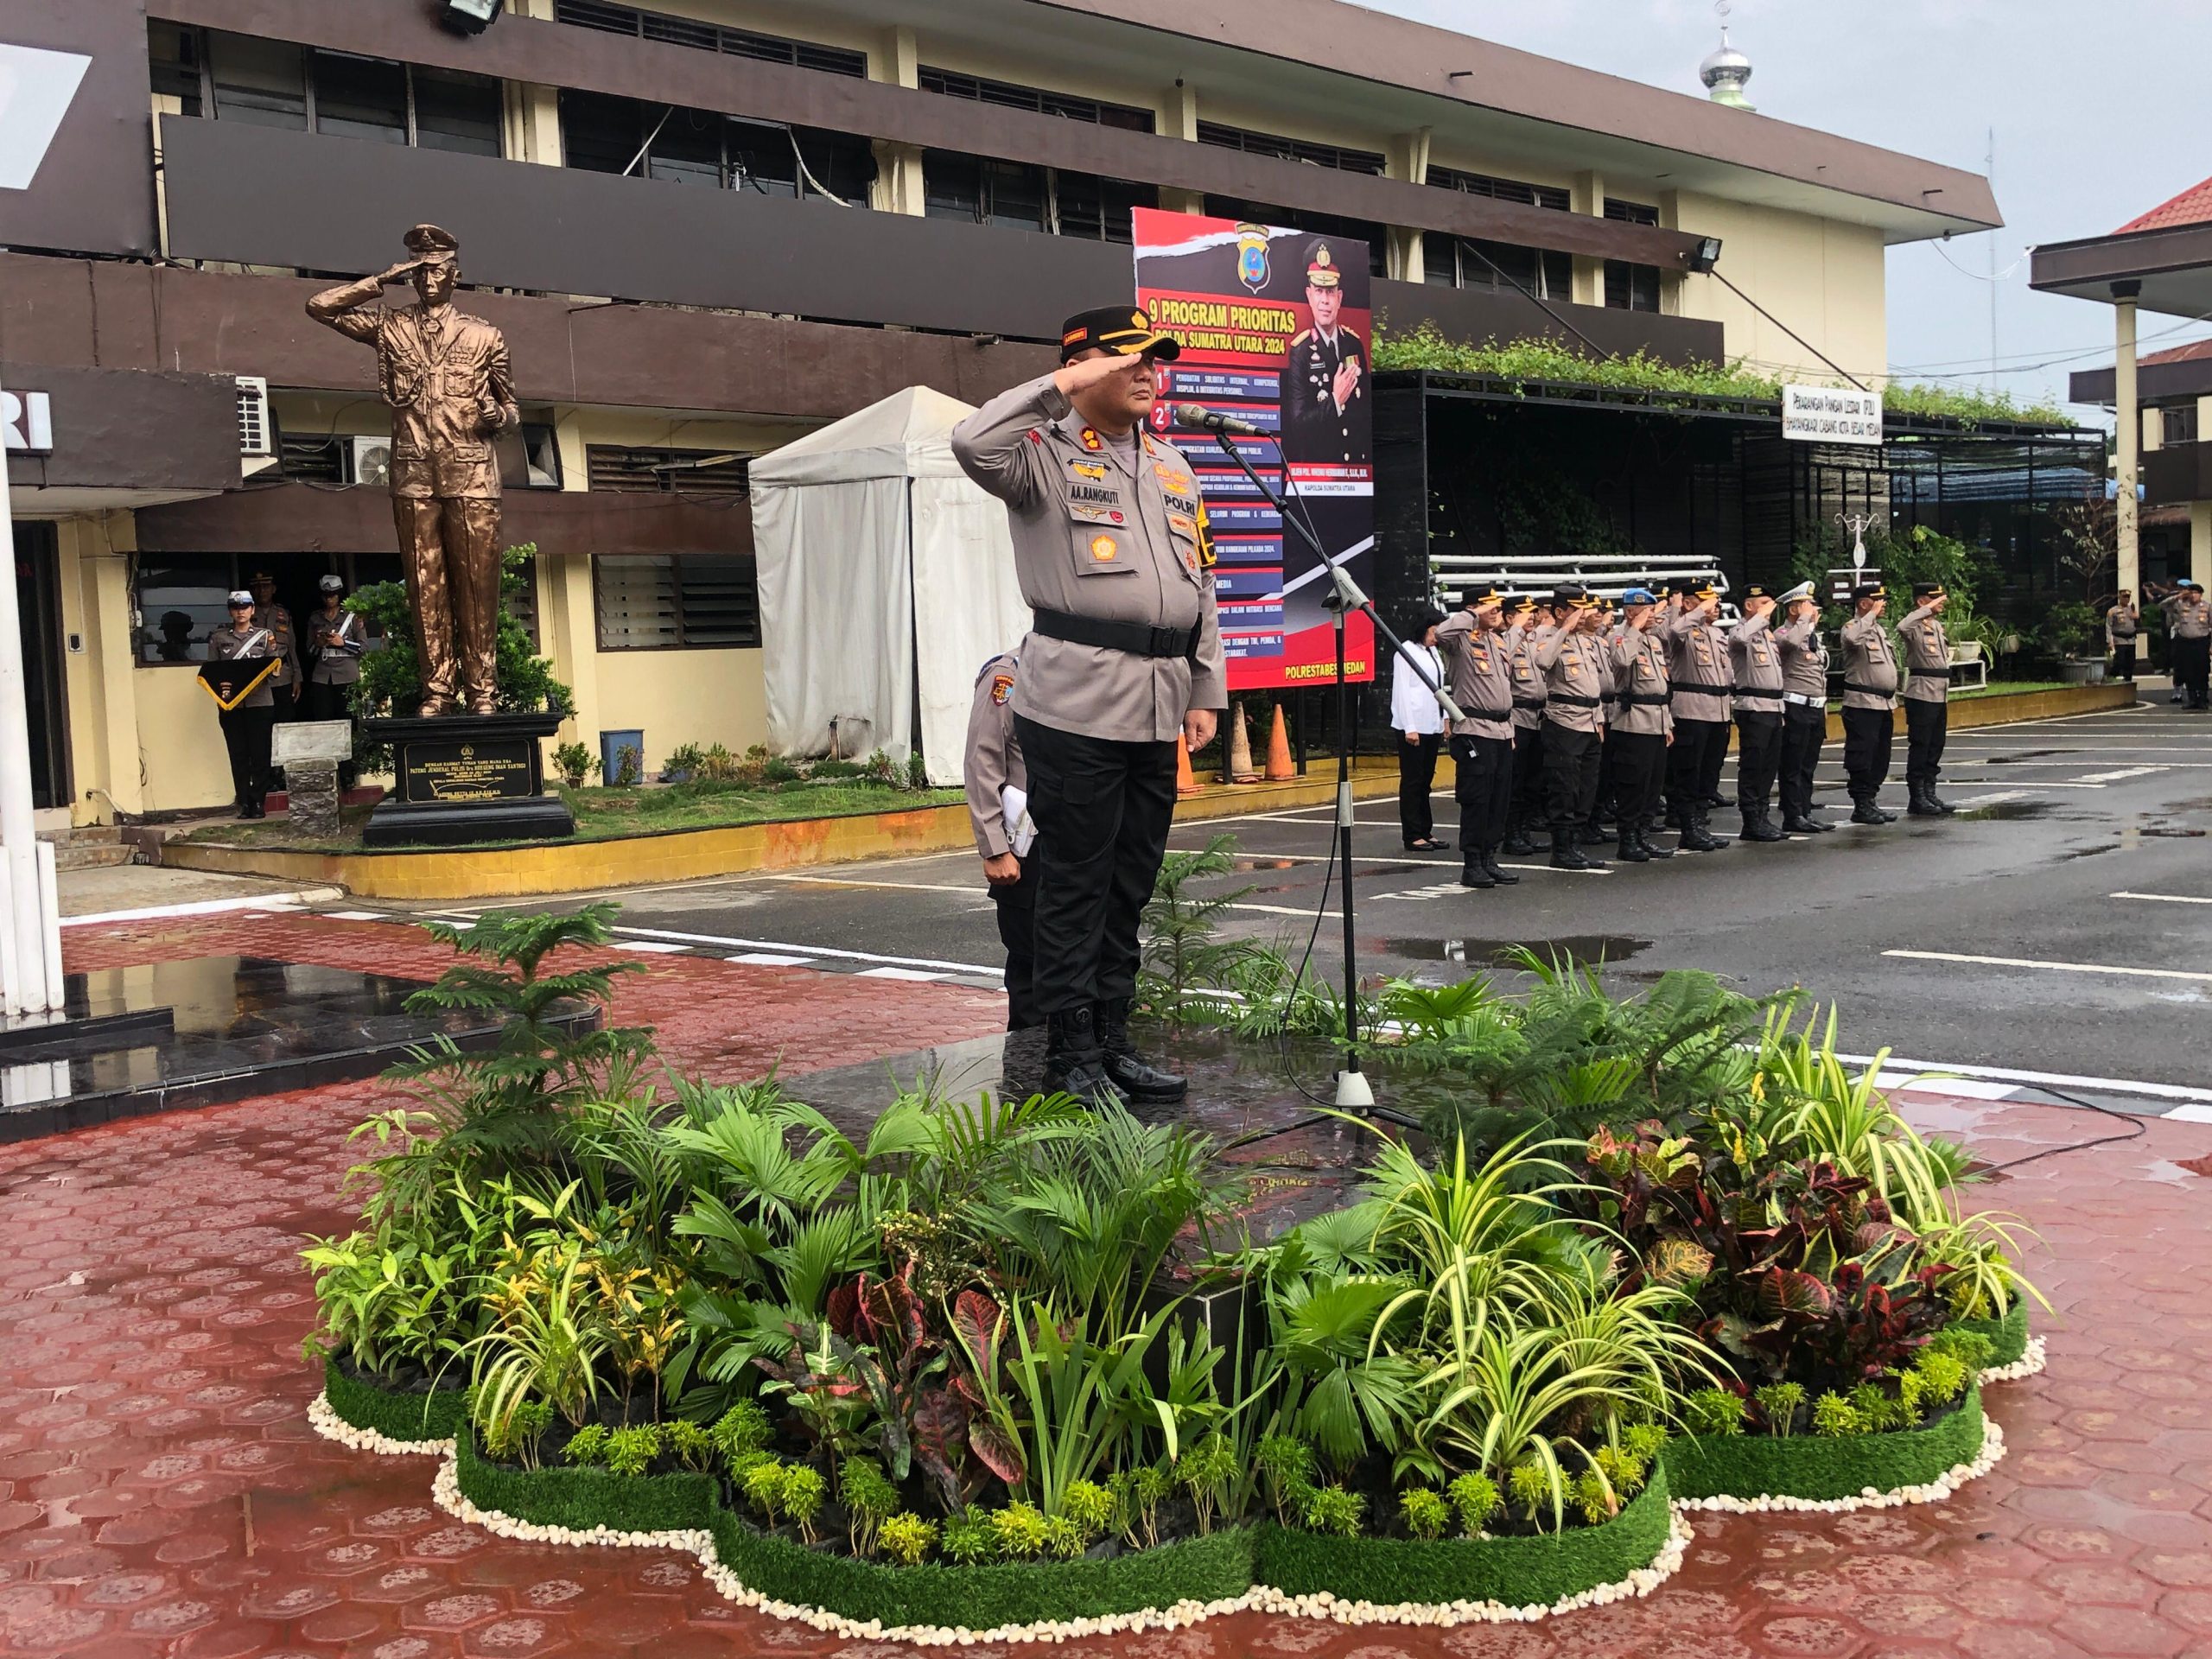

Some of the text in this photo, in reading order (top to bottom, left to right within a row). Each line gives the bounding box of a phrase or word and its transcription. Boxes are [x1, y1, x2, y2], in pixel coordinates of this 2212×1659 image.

[1148, 299, 1296, 334] 9 PROGRAM PRIORITAS
[1188, 331, 1233, 351] SUMATRA
[1234, 335, 1263, 353] UTARA
[1264, 338, 1286, 355] 2024
[1157, 372, 1163, 390] 1
[1155, 407, 1165, 425] 2
[1071, 485, 1120, 505] AA.RANGKUTI
[1163, 493, 1196, 517] POLRI
[1215, 579, 1232, 589] MEDIA
[1285, 661, 1366, 680] POLRESTABES EDAN
